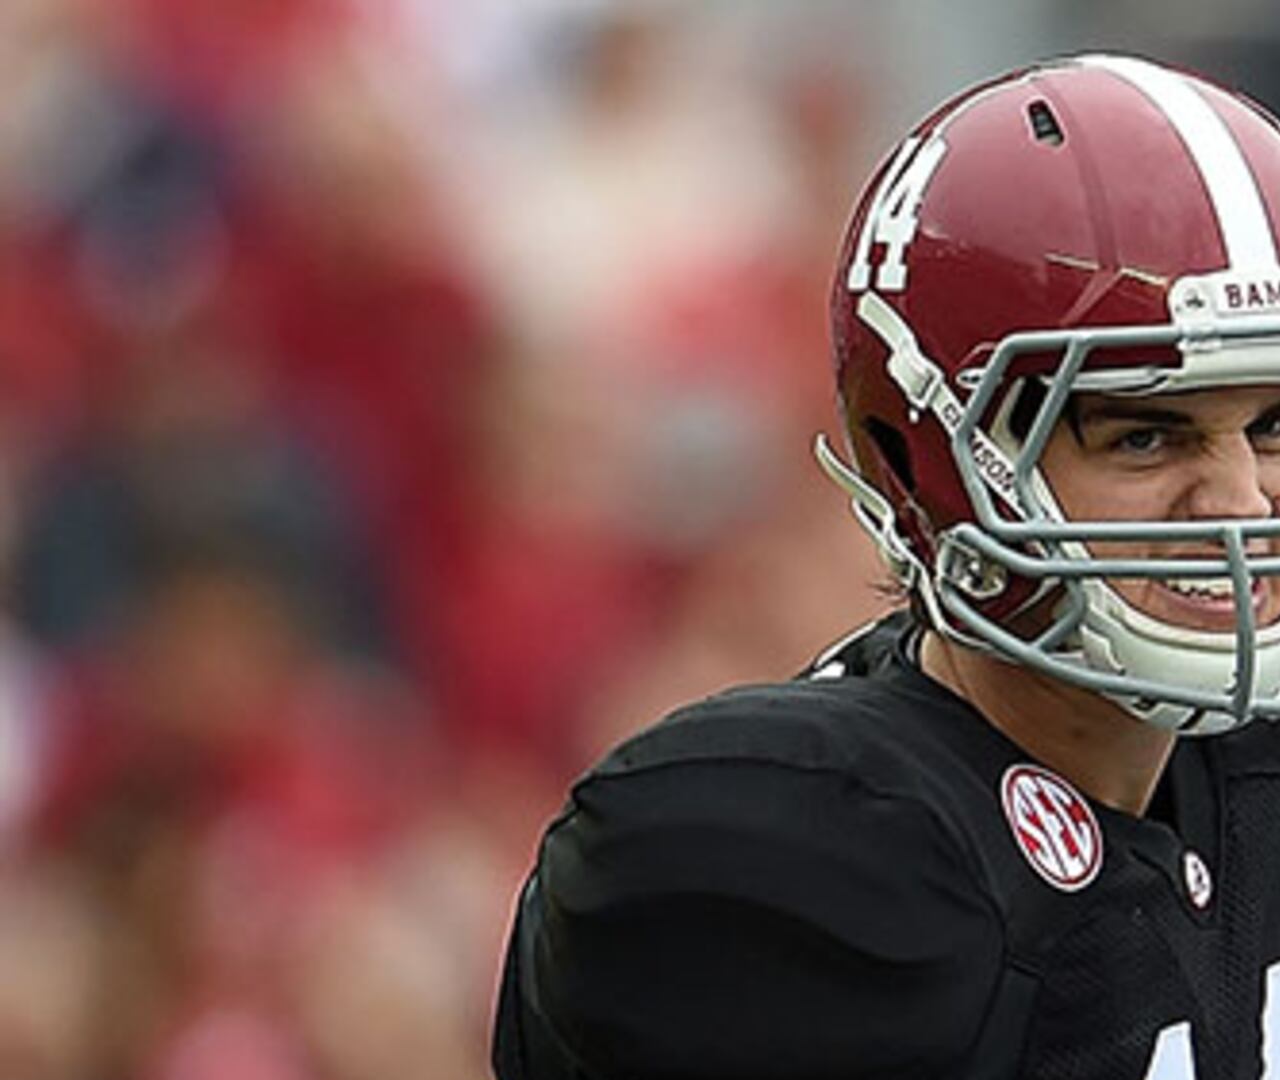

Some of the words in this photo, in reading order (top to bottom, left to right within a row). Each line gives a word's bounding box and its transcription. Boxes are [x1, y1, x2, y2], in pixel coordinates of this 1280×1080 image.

[848, 137, 948, 289] 14
[943, 402, 1015, 492] CMSON
[1007, 774, 1098, 880] SEC
